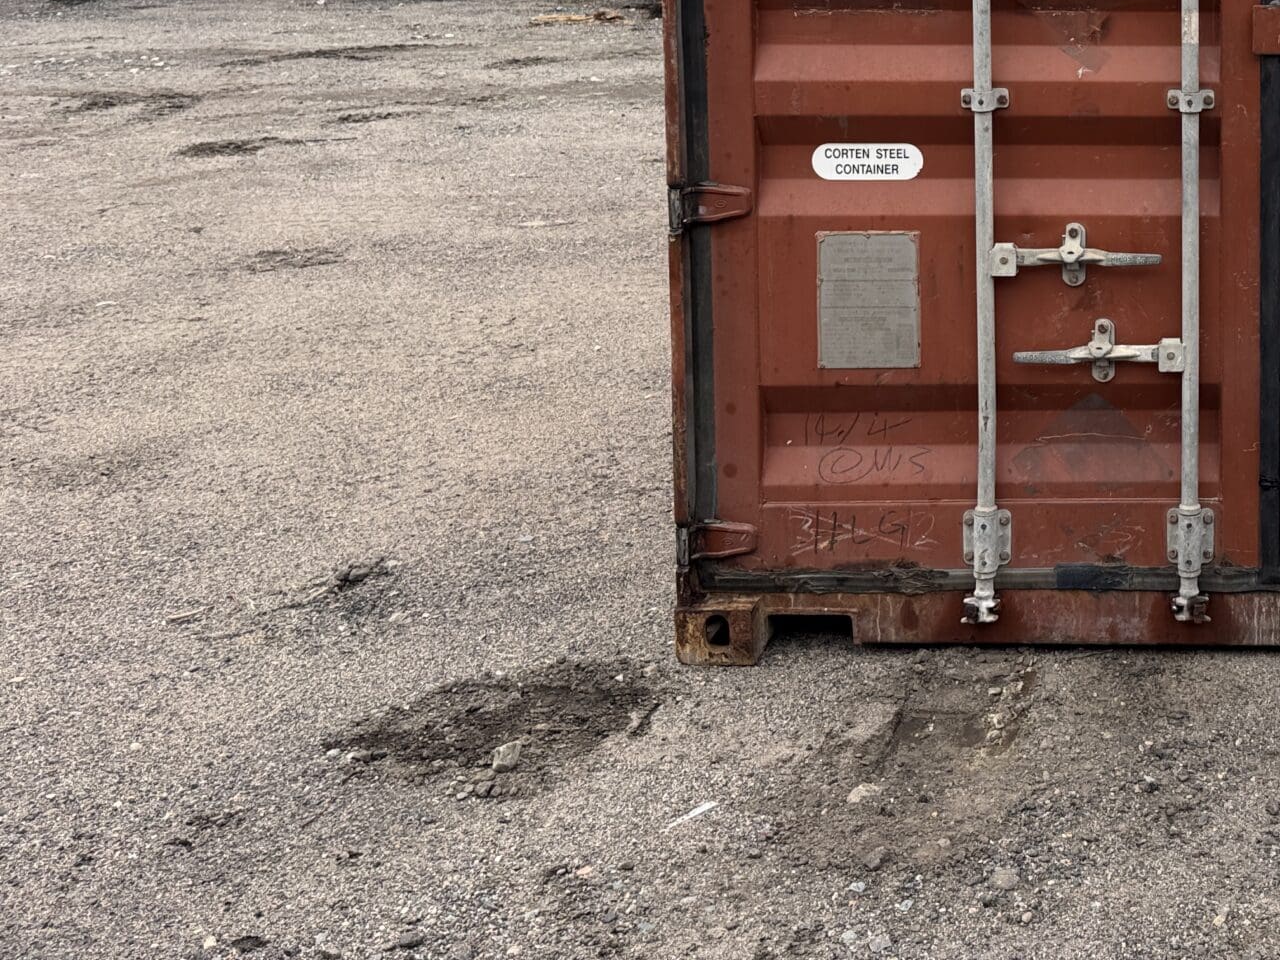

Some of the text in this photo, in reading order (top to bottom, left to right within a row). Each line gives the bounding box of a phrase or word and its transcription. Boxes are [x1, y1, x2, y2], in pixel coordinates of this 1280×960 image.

[824, 148, 910, 159] CORTEN STEEL
[835, 163, 899, 175] CONTAINER
